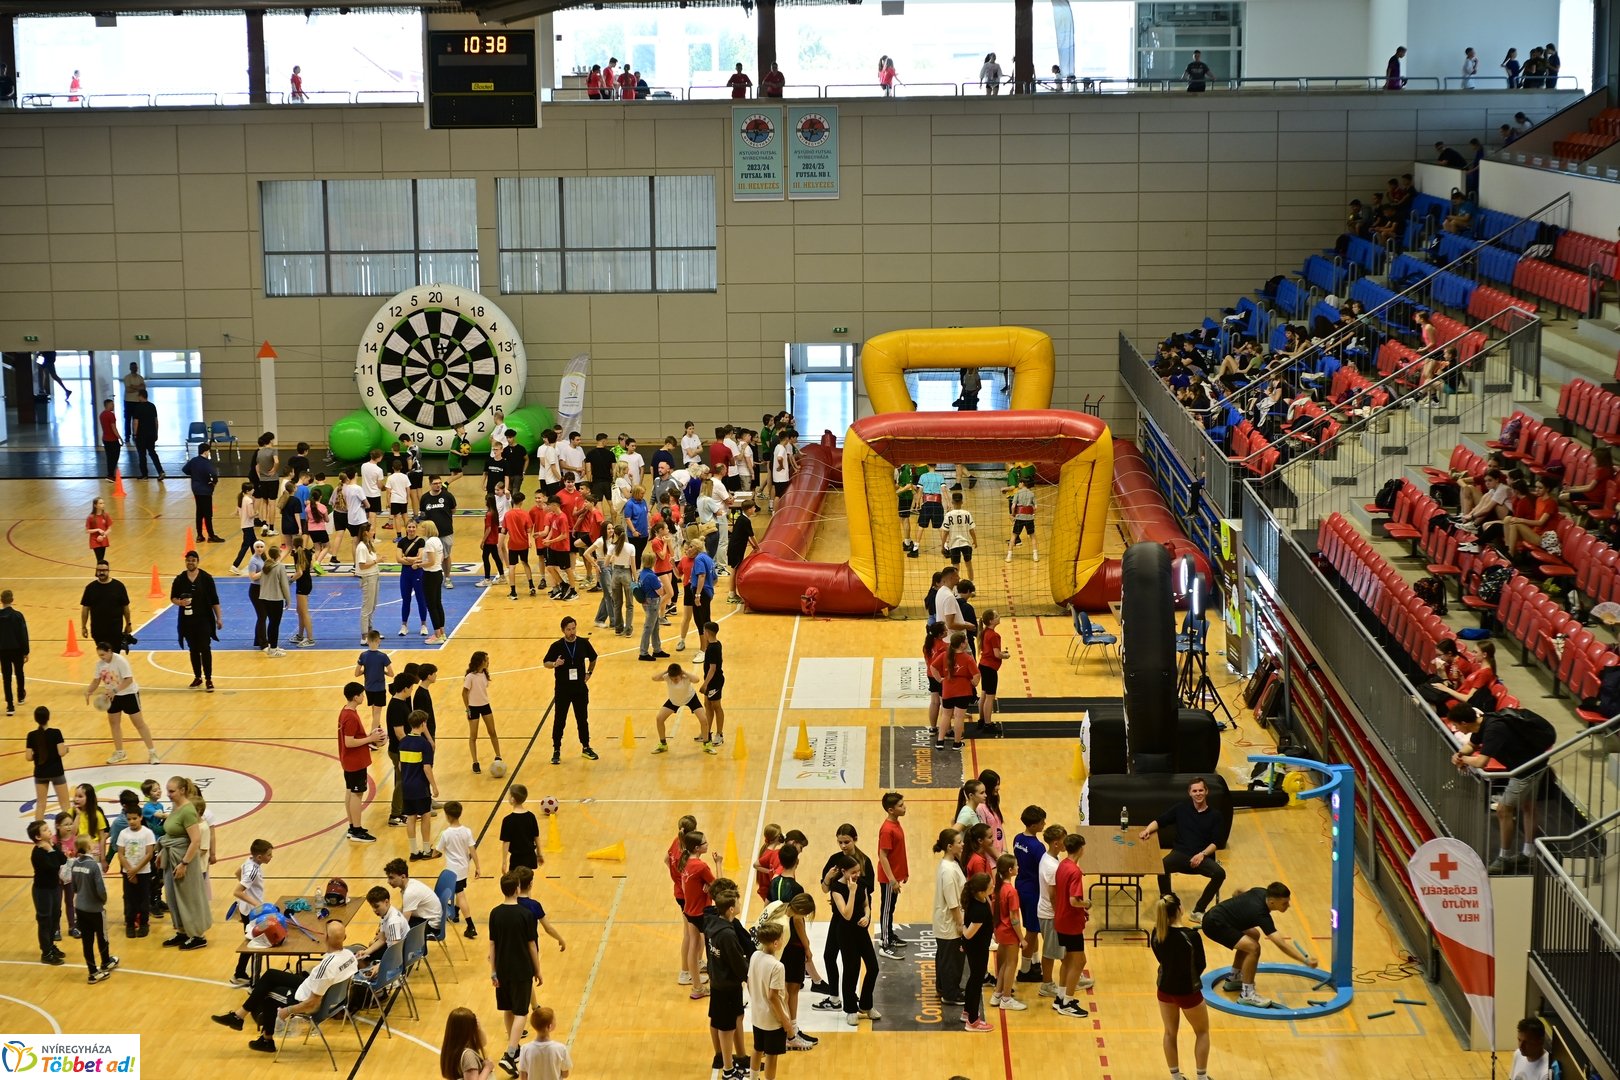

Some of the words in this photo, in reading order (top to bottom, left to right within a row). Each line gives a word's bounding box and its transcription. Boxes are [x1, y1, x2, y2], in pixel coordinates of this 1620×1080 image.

[464, 35, 507, 53] 10:38
[411, 296, 418, 306] 5
[428, 292, 442, 303] 20
[455, 296, 459, 306] 1
[389, 306, 402, 317] 12
[471, 306, 484, 317] 18
[377, 322, 384, 333] 9
[490, 322, 497, 332] 4
[364, 343, 377, 353] 14
[498, 342, 512, 352] 13
[361, 365, 373, 375] 11
[505, 364, 512, 374] 6
[367, 387, 374, 396] 8
[498, 385, 512, 395] 10
[374, 406, 387, 416] 16
[394, 422, 400, 432] 7
[478, 422, 484, 432] 2
[410, 432, 424, 442] 19
[436, 436, 443, 446] 3
[911, 729, 931, 748] Aréna
[823, 730, 839, 767] SPORTCENTRUM
[911, 748, 933, 784] Continental
[915, 960, 942, 1023] Continental
